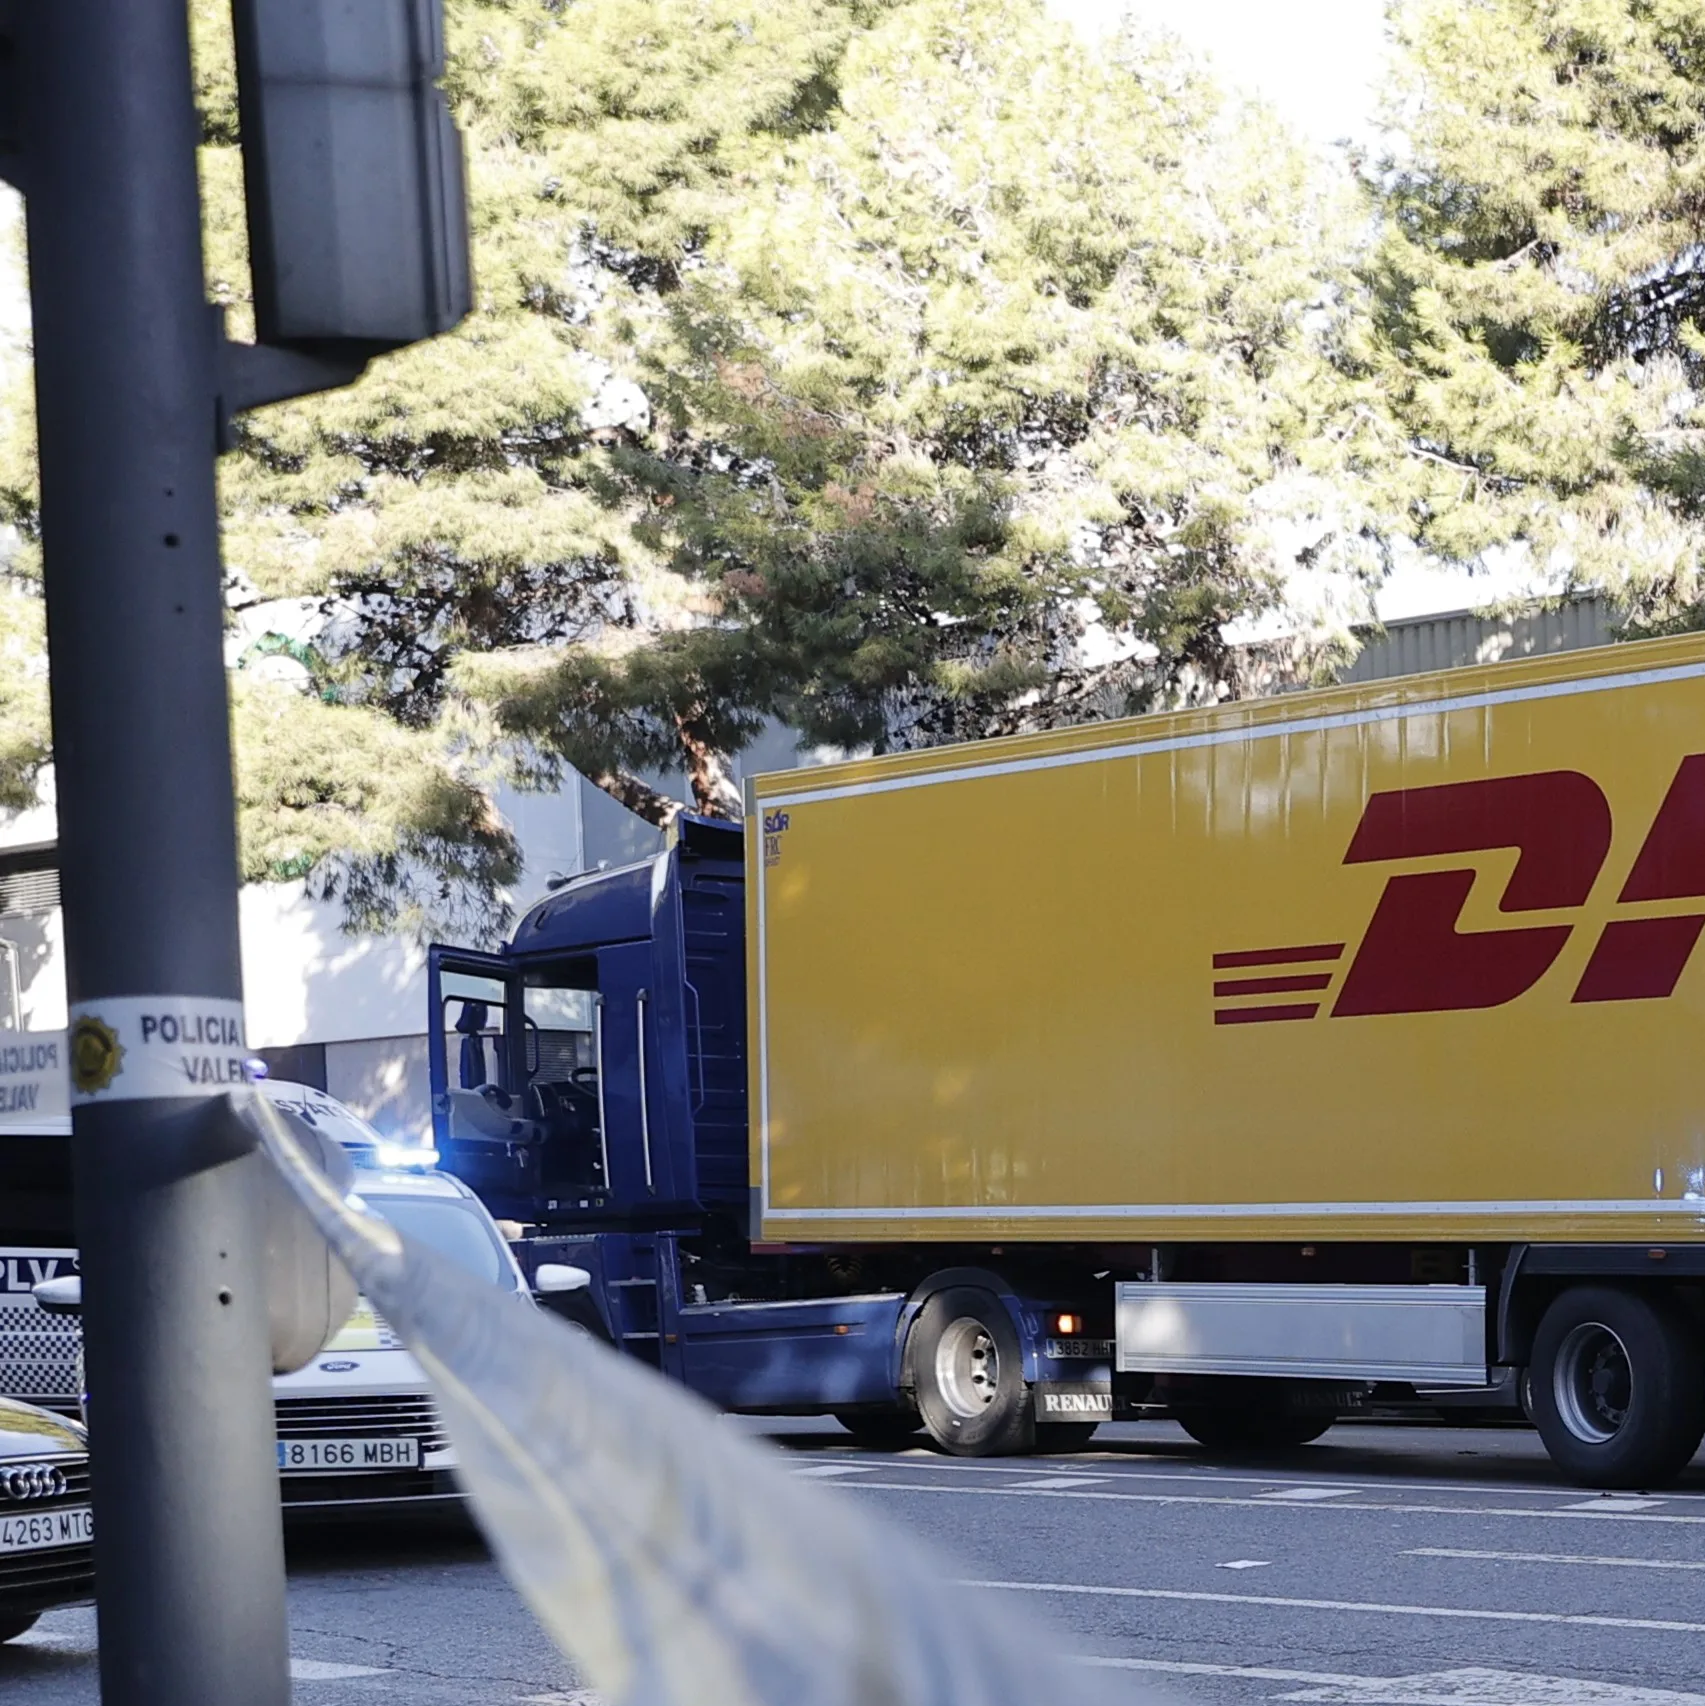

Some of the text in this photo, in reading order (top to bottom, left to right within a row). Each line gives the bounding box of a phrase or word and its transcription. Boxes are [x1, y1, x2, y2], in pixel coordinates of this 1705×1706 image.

[140, 1014, 240, 1047] POLICIA
[291, 1442, 410, 1465] 8166 MBH
[2, 1511, 94, 1547] 4263 MTG
